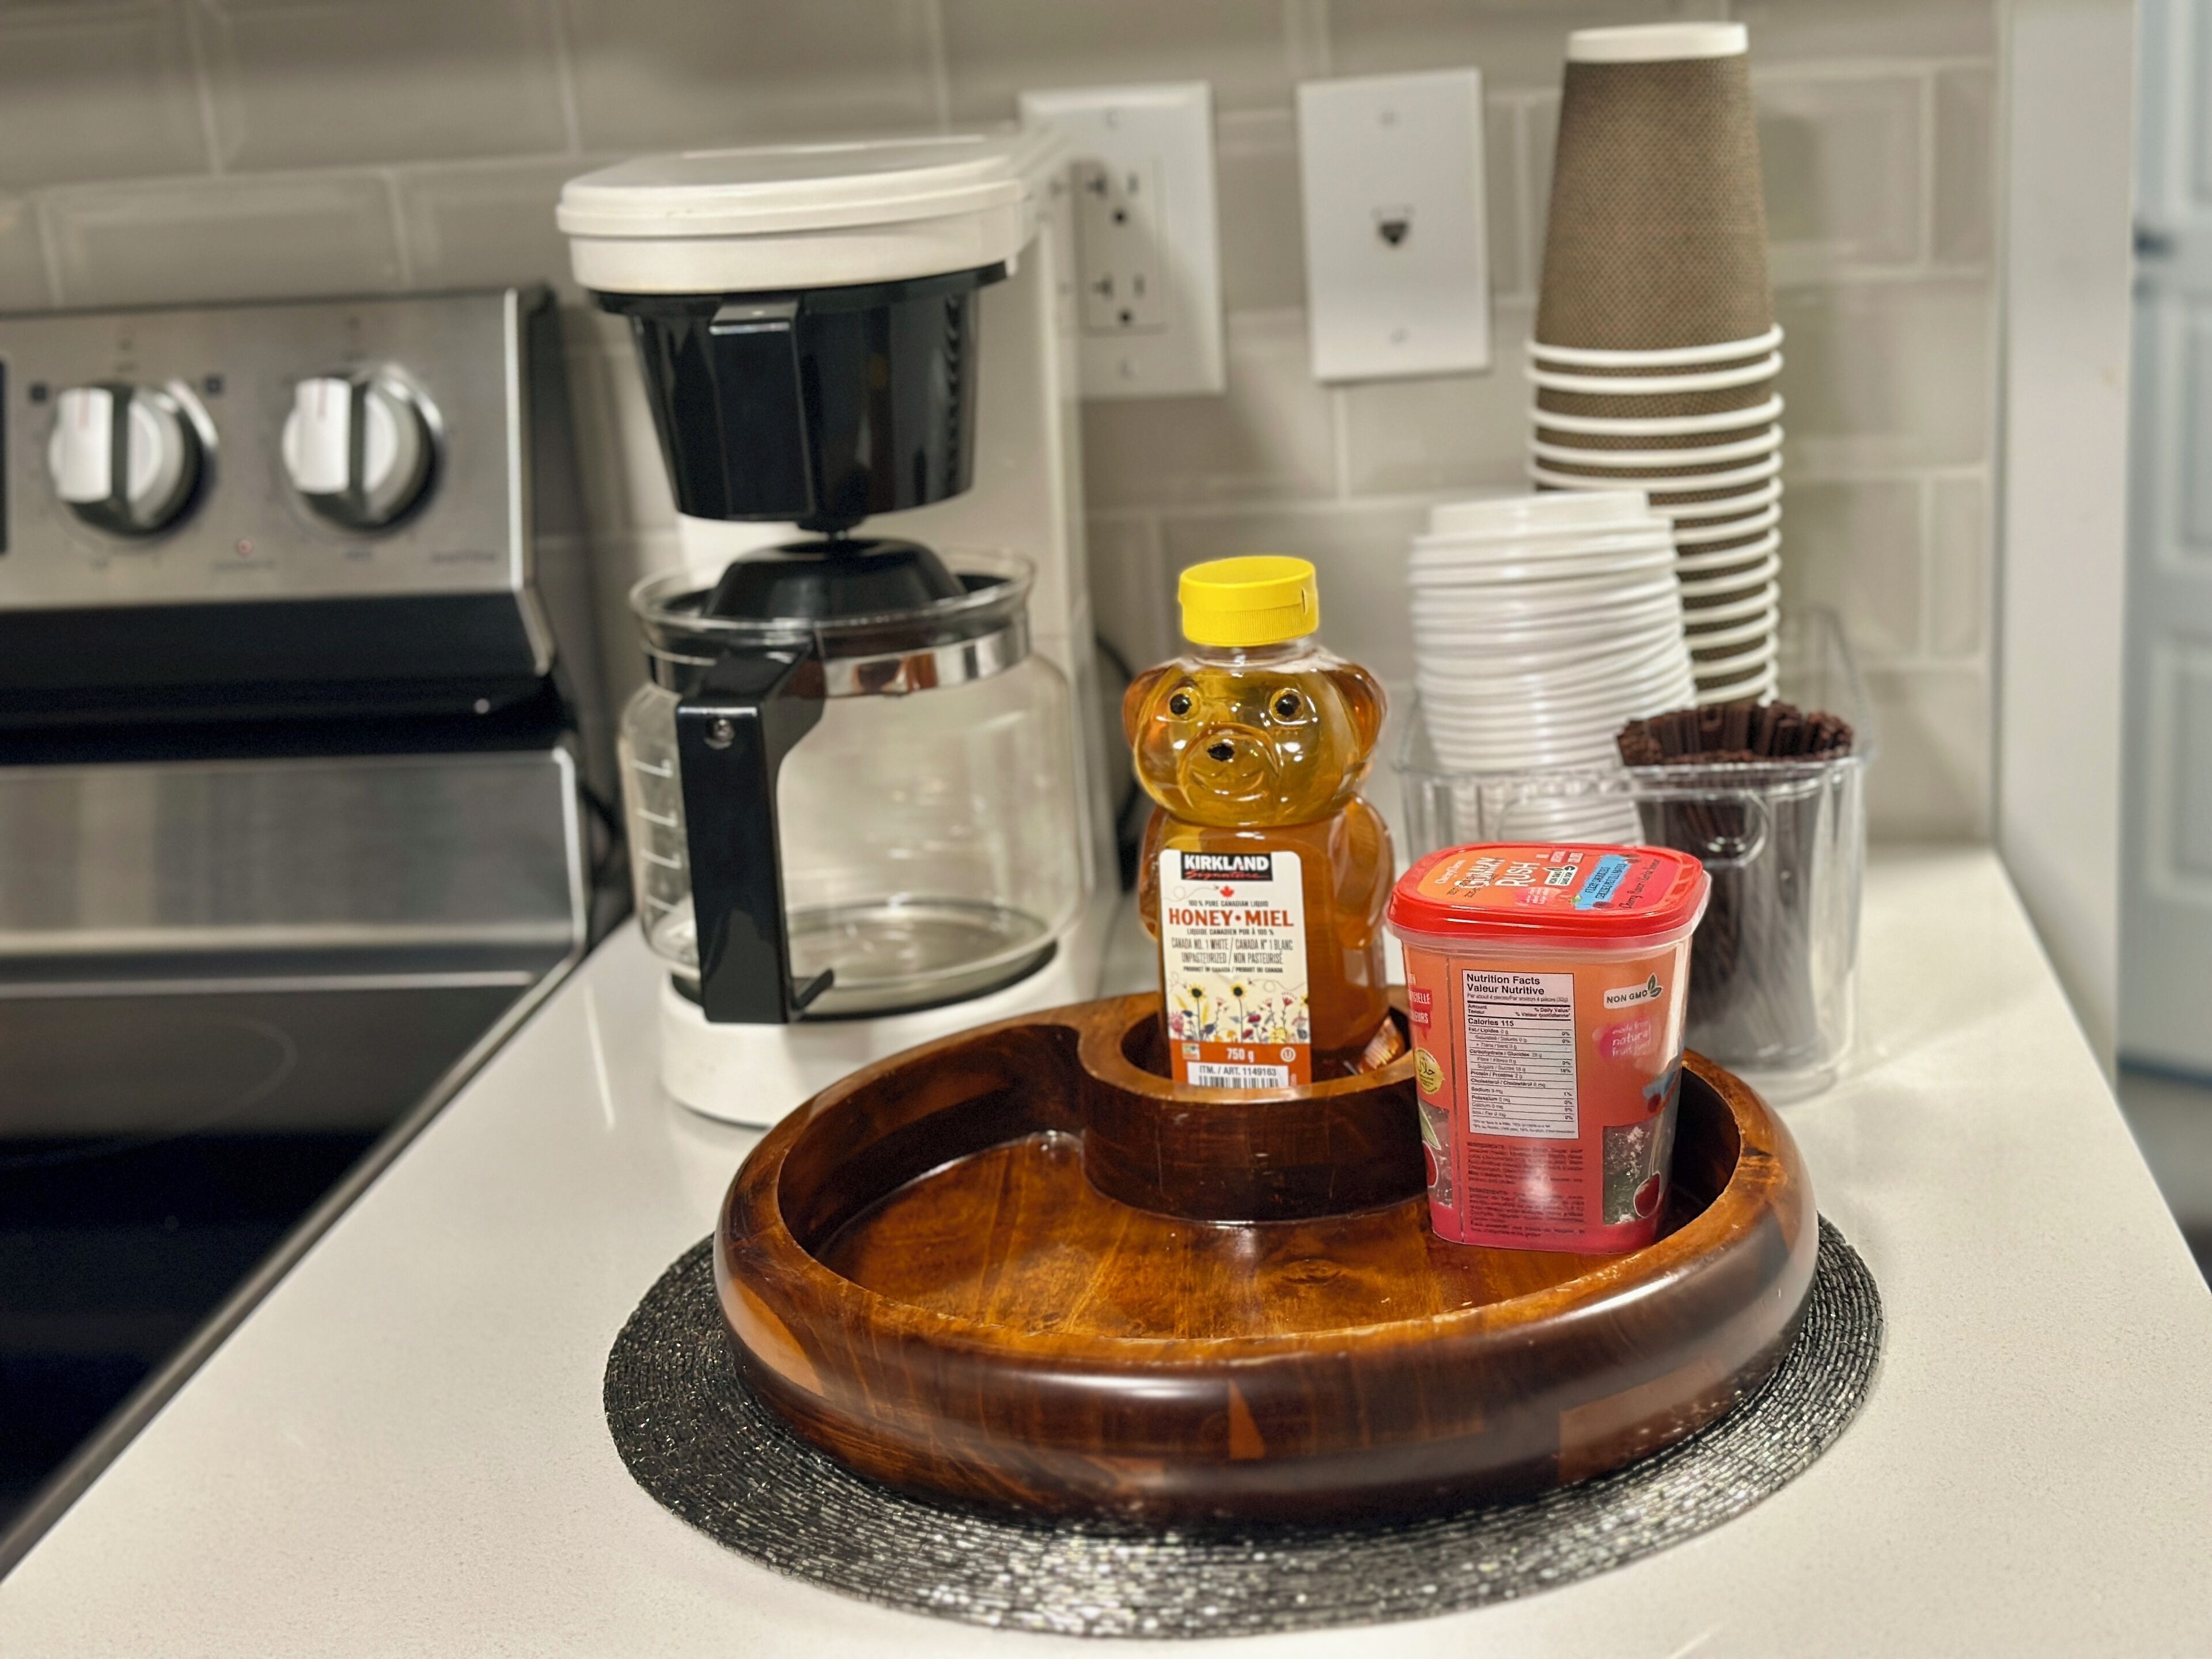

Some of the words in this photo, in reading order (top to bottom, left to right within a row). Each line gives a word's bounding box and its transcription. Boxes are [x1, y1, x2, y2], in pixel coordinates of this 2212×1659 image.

[1184, 854, 1269, 871] KIRKLAND
[1184, 870, 1269, 880] Signature
[1454, 857, 1505, 888] GUMMY
[1495, 861, 1540, 887] RUSH
[1619, 895, 1643, 908] Cherry
[1169, 908, 1233, 926] HONEY
[1245, 910, 1294, 927] MIEL
[1172, 938, 1192, 950] CANADA
[1194, 939, 1204, 950] NO.
[1210, 939, 1229, 950] WHITE
[1235, 939, 1259, 950] CANADA
[1274, 939, 1293, 950] BLANC
[1181, 952, 1226, 964] UNPASTEURIZED
[1234, 953, 1245, 964] NON
[1248, 951, 1283, 964] PASTEURISÉ
[1467, 974, 1509, 984] Nutrition
[1513, 976, 1540, 984] Facts
[1467, 983, 1498, 993] Valeur
[1501, 986, 1544, 995] Nutritive
[1607, 994, 1626, 1003] NON
[1629, 990, 1647, 999] GMO
[1468, 1018, 1498, 1026] Calories
[1613, 1025, 1651, 1047] natural
[1226, 1048, 1245, 1060] 750
[1248, 1050, 1254, 1063] g
[1199, 1065, 1215, 1074] ITM.
[1223, 1066, 1241, 1075] ART.
[1242, 1067, 1277, 1076] 1149163
